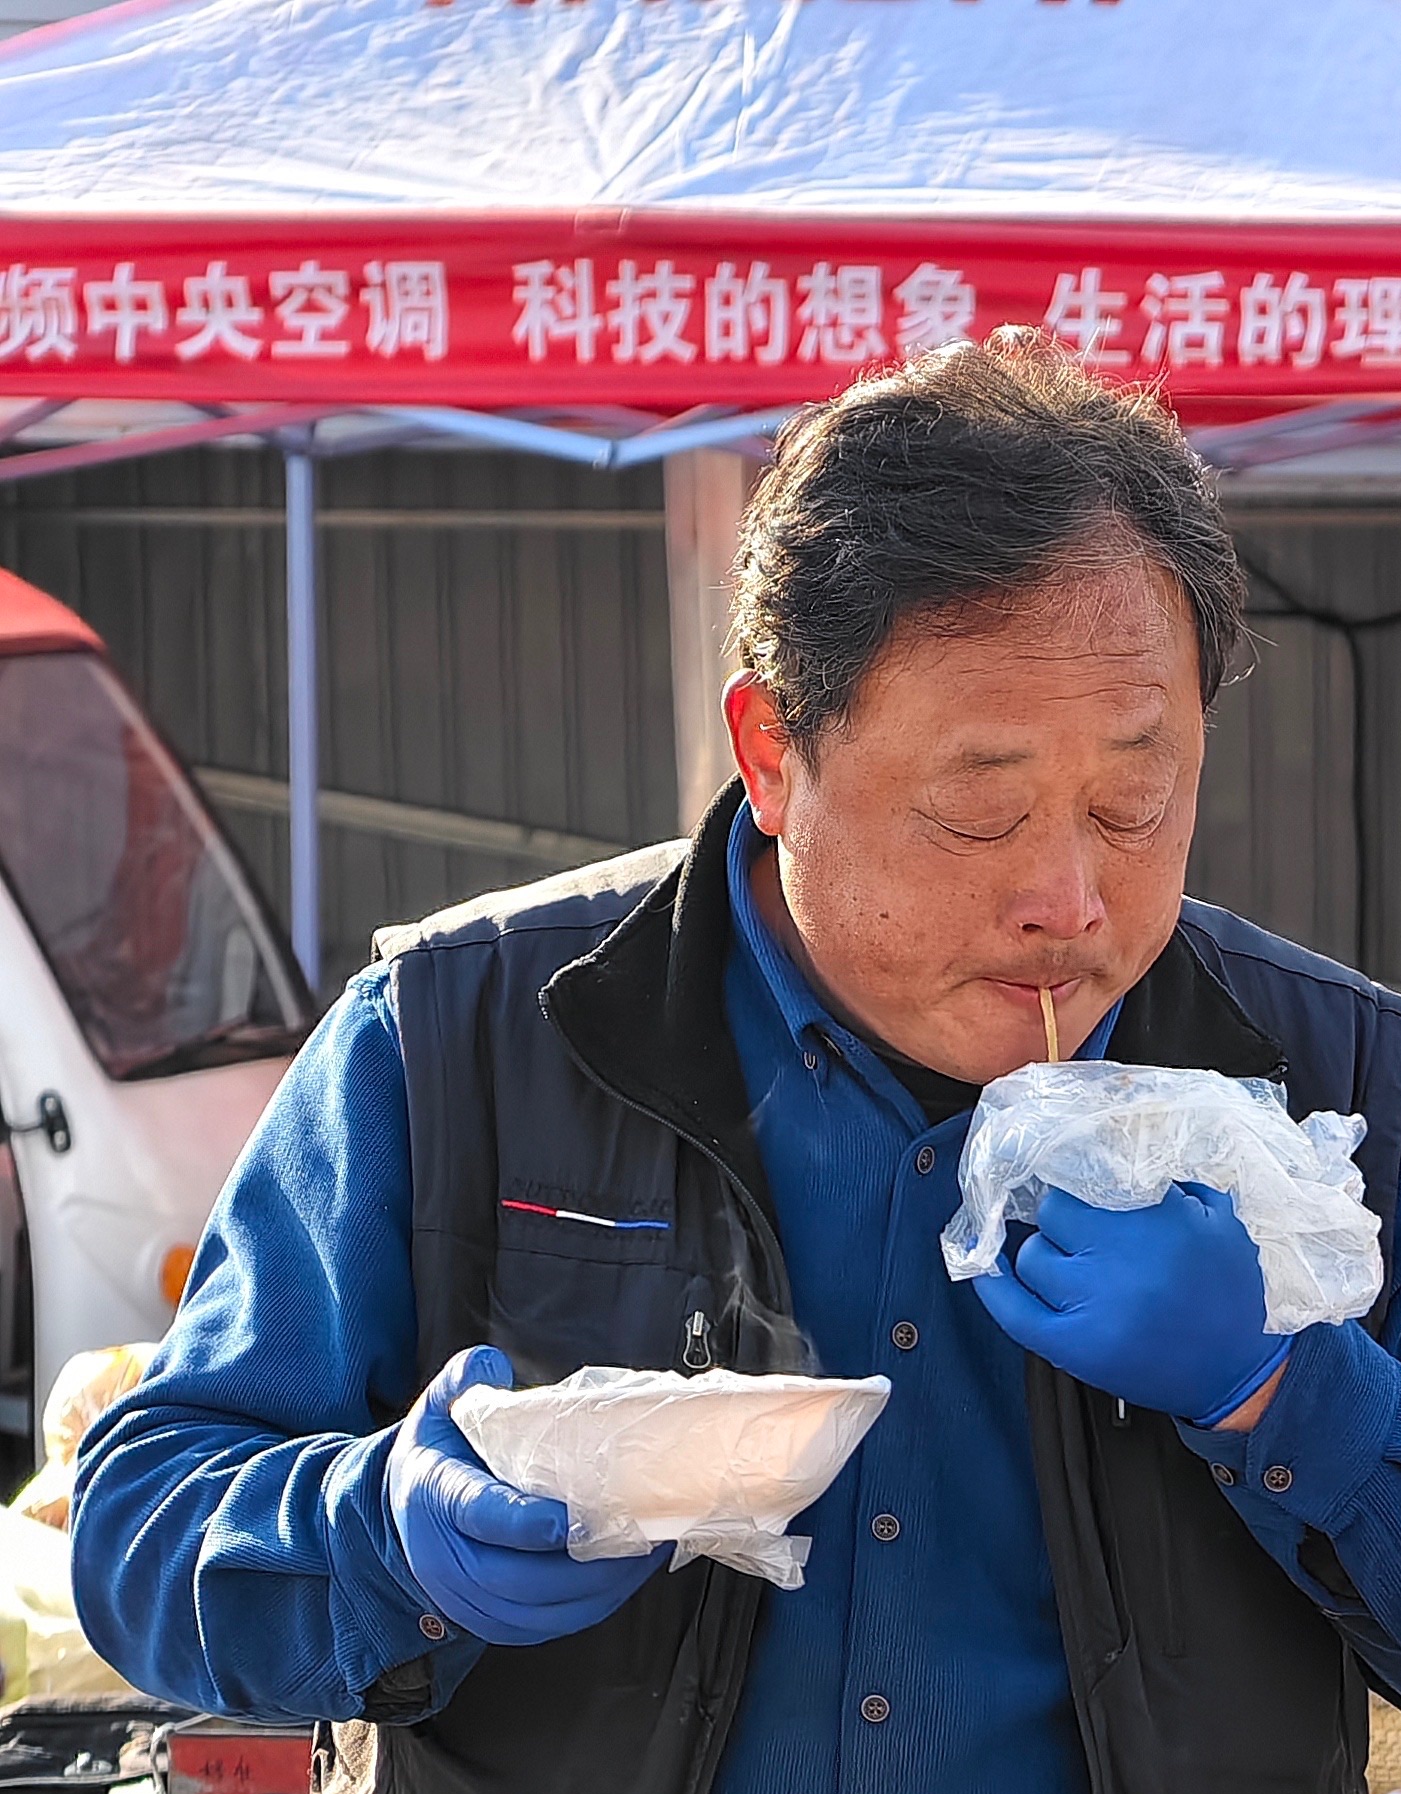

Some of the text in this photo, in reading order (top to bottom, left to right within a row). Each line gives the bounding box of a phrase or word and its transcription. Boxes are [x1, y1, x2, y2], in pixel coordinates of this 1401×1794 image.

[512, 257, 976, 363] 科技的想象
